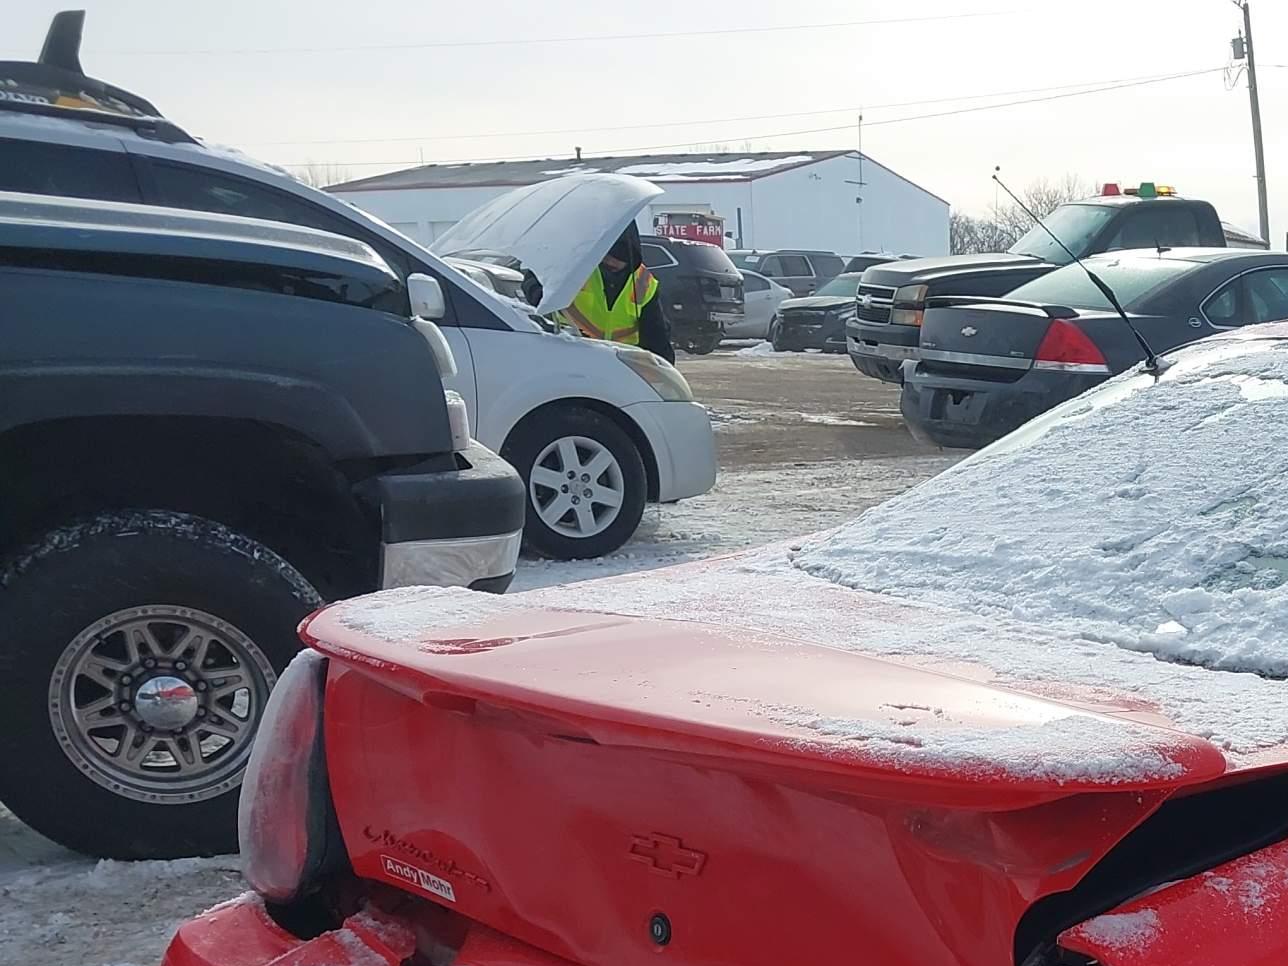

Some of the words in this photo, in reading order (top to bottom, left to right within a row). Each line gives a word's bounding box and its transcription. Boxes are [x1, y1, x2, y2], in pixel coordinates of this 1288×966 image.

[656, 225, 688, 236] STATE
[696, 225, 721, 236] FARM
[385, 858, 420, 884] Andy
[420, 874, 453, 897] Mohr
